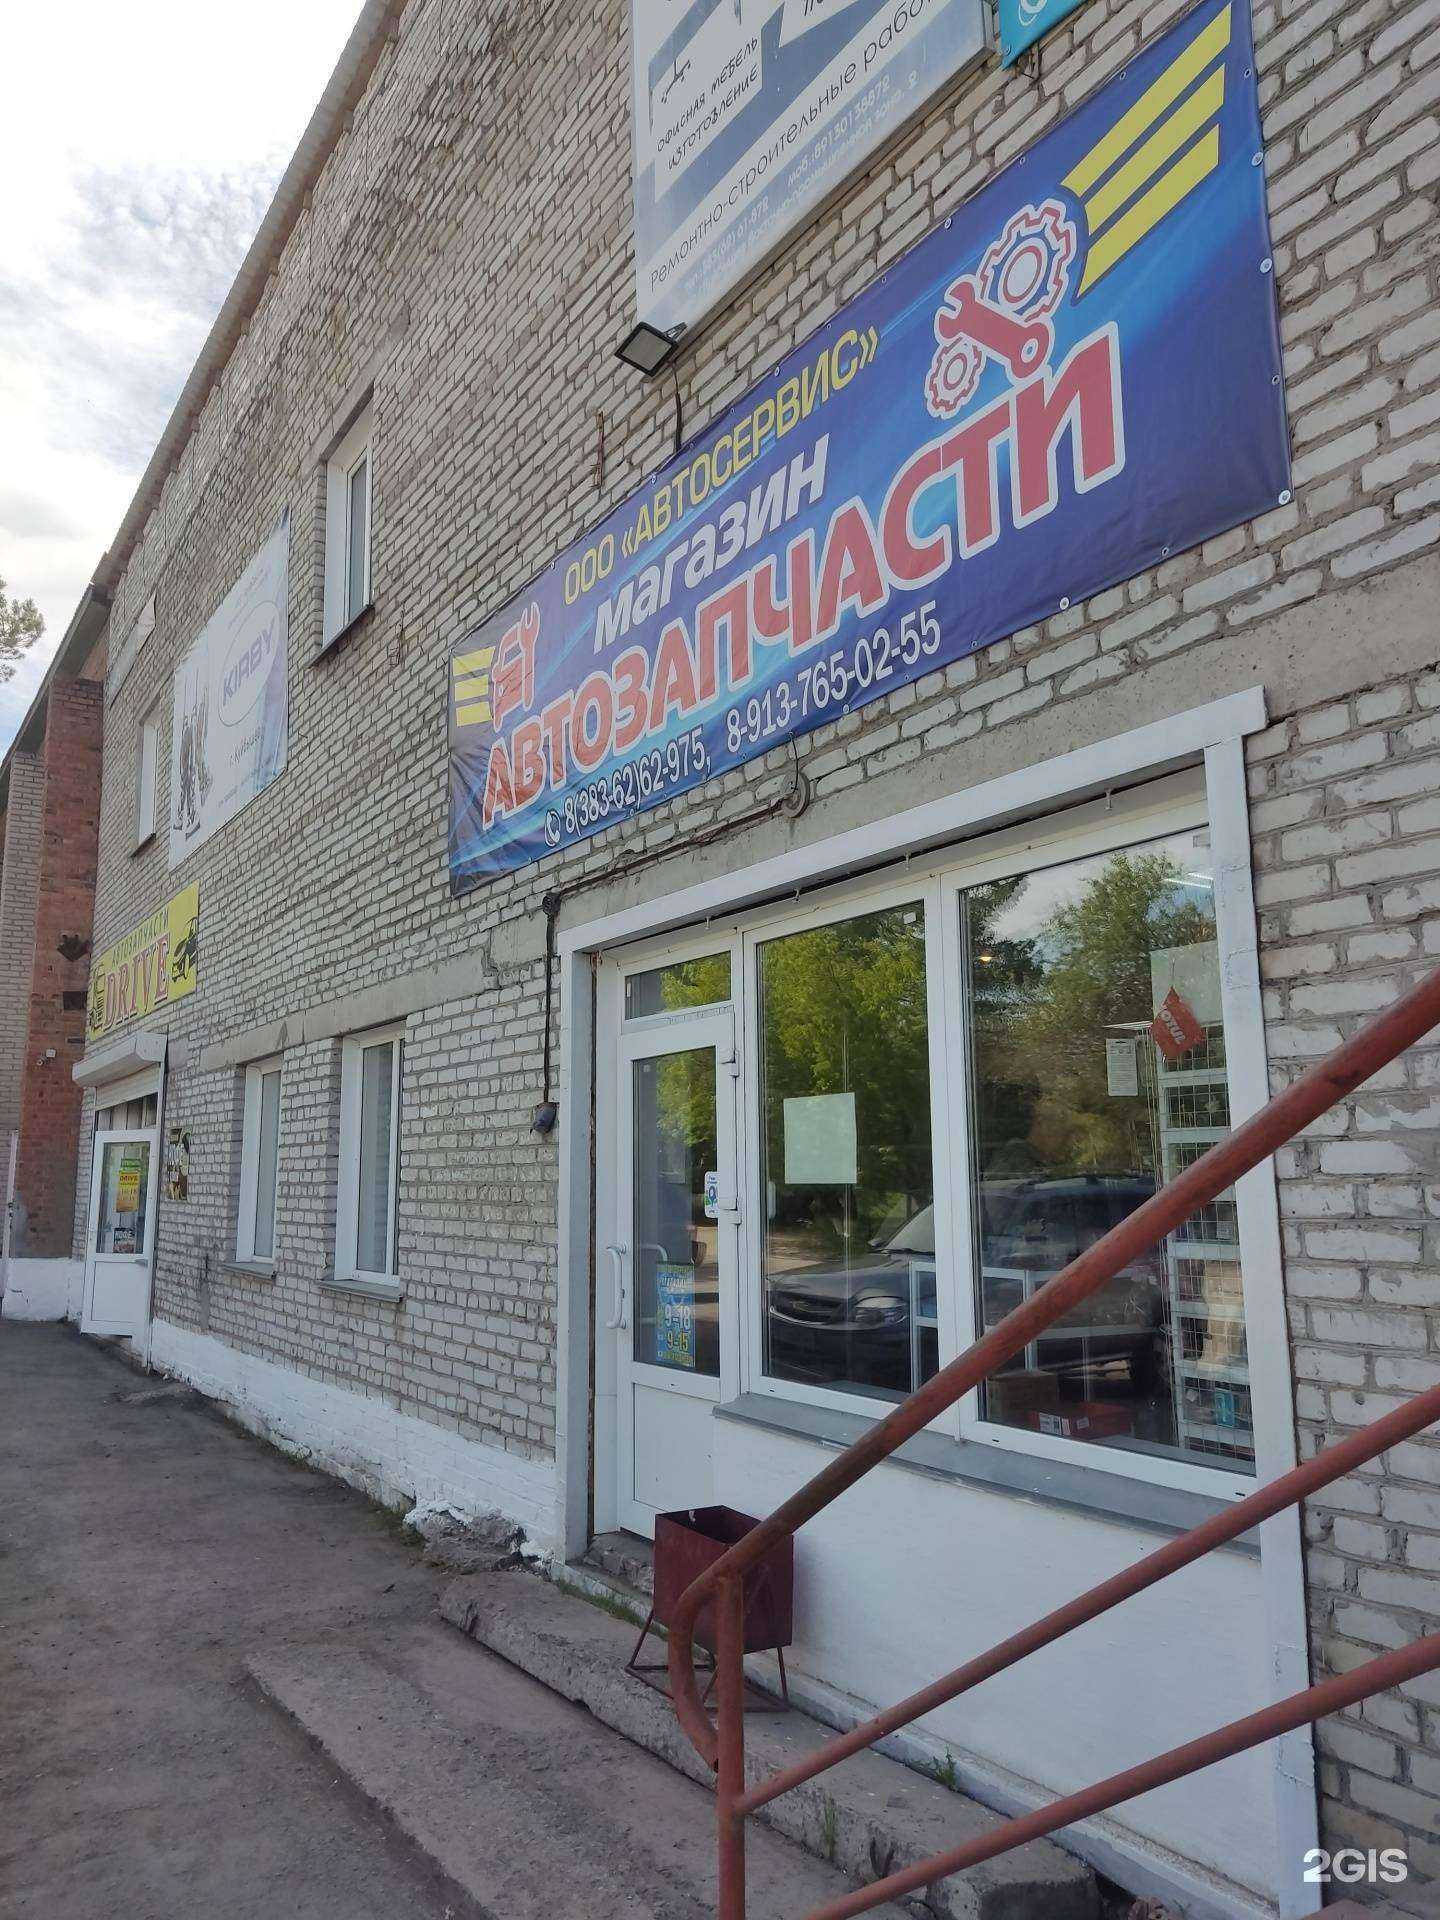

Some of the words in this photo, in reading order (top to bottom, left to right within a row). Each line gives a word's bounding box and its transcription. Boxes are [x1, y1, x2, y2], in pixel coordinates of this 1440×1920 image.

[650, 62, 857, 293] Ремонтно-строительные
[657, 92, 706, 152] ОФИСНАЯ
[668, 63, 758, 170] ИЗГОТОВЛЕНИЕ
[564, 533, 616, 605] ООО
[620, 325, 879, 559] «АВТОСЕРВИС»
[482, 320, 1126, 831] АВТОЗАПЧАСТИ
[222, 612, 276, 707] KIRBY
[726, 600, 941, 754] 8-913-765-02-55
[103, 931, 170, 1032] DRIVE
